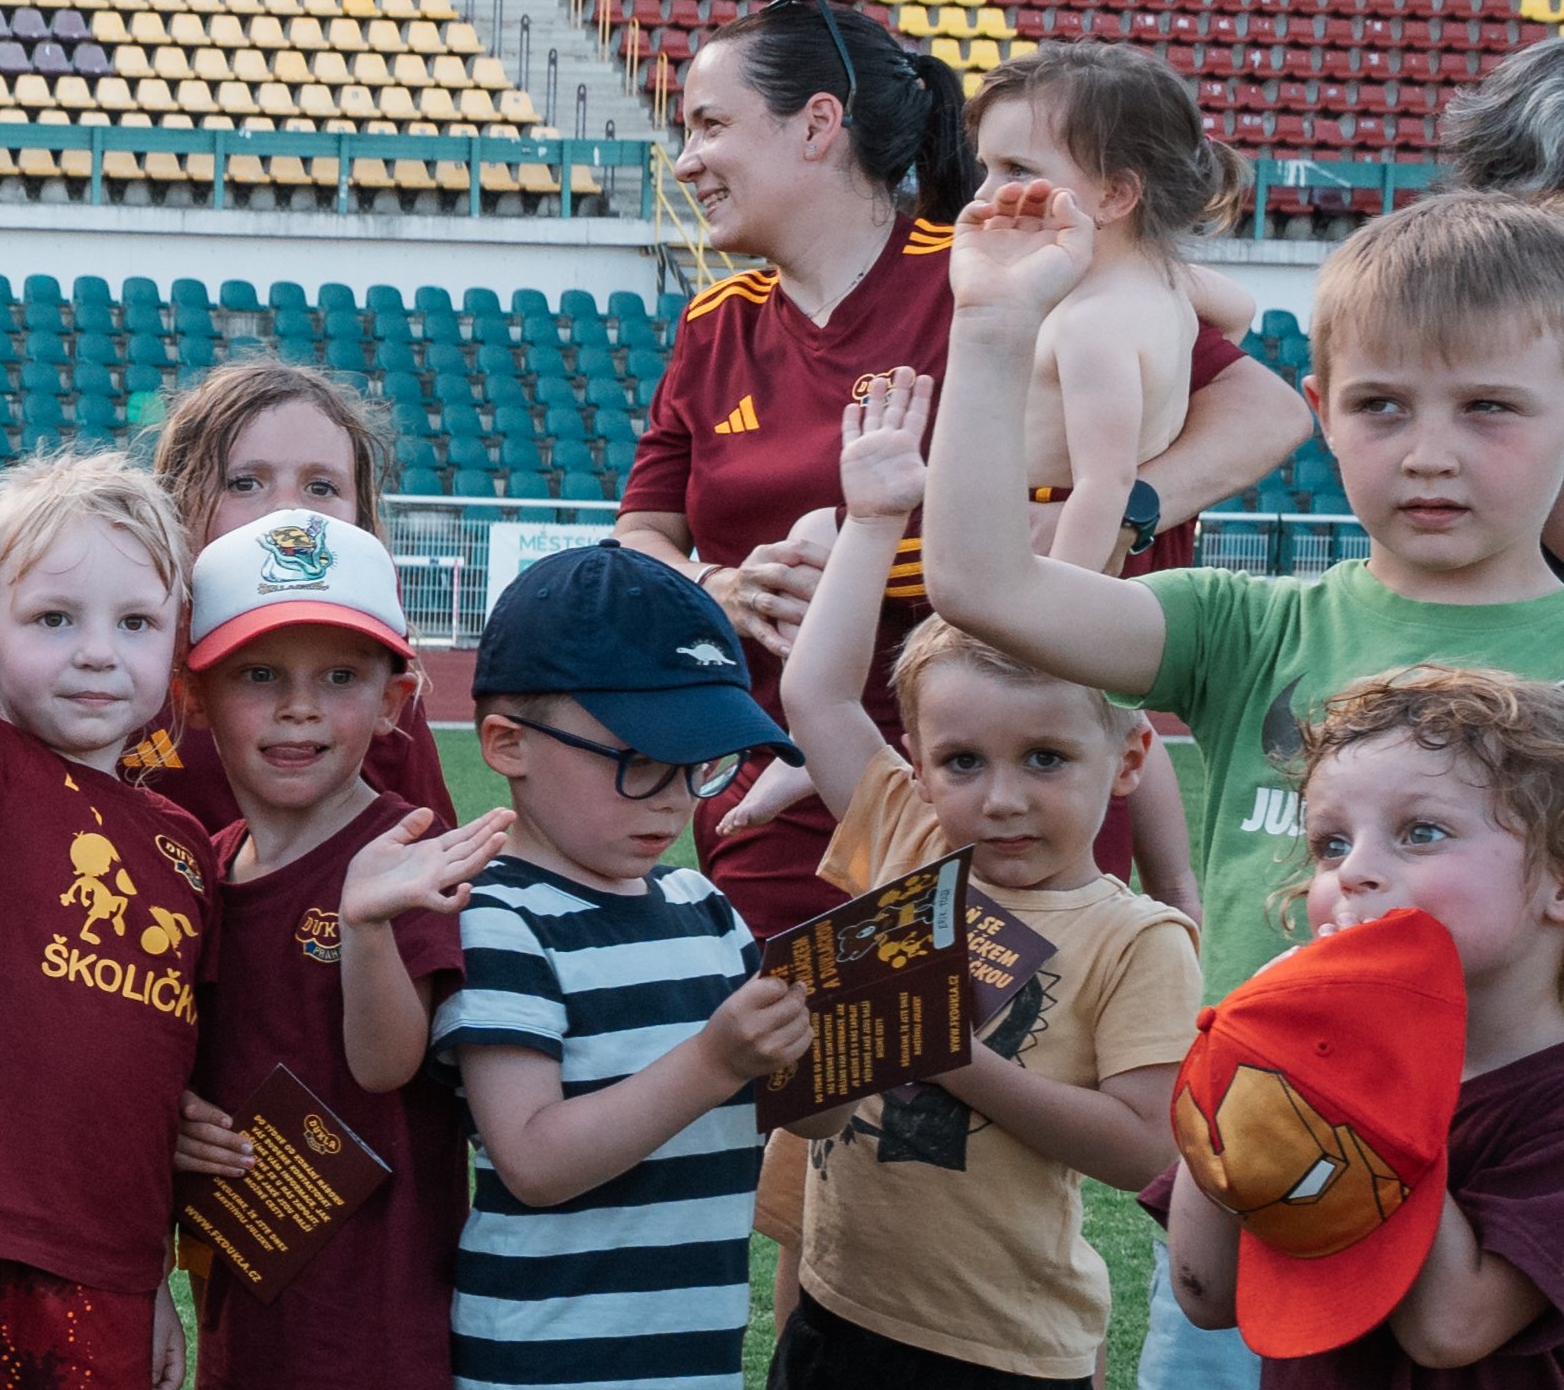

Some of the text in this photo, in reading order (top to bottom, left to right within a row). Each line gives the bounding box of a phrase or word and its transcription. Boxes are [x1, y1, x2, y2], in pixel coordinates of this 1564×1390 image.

[301, 917, 338, 939] DUK
[312, 945, 339, 960] PRAH
[41, 933, 199, 1025] ŠKOLIČK
[308, 1118, 337, 1151] DUKLA
[184, 1204, 263, 1284] WWW.FKDUKLA.CZ
